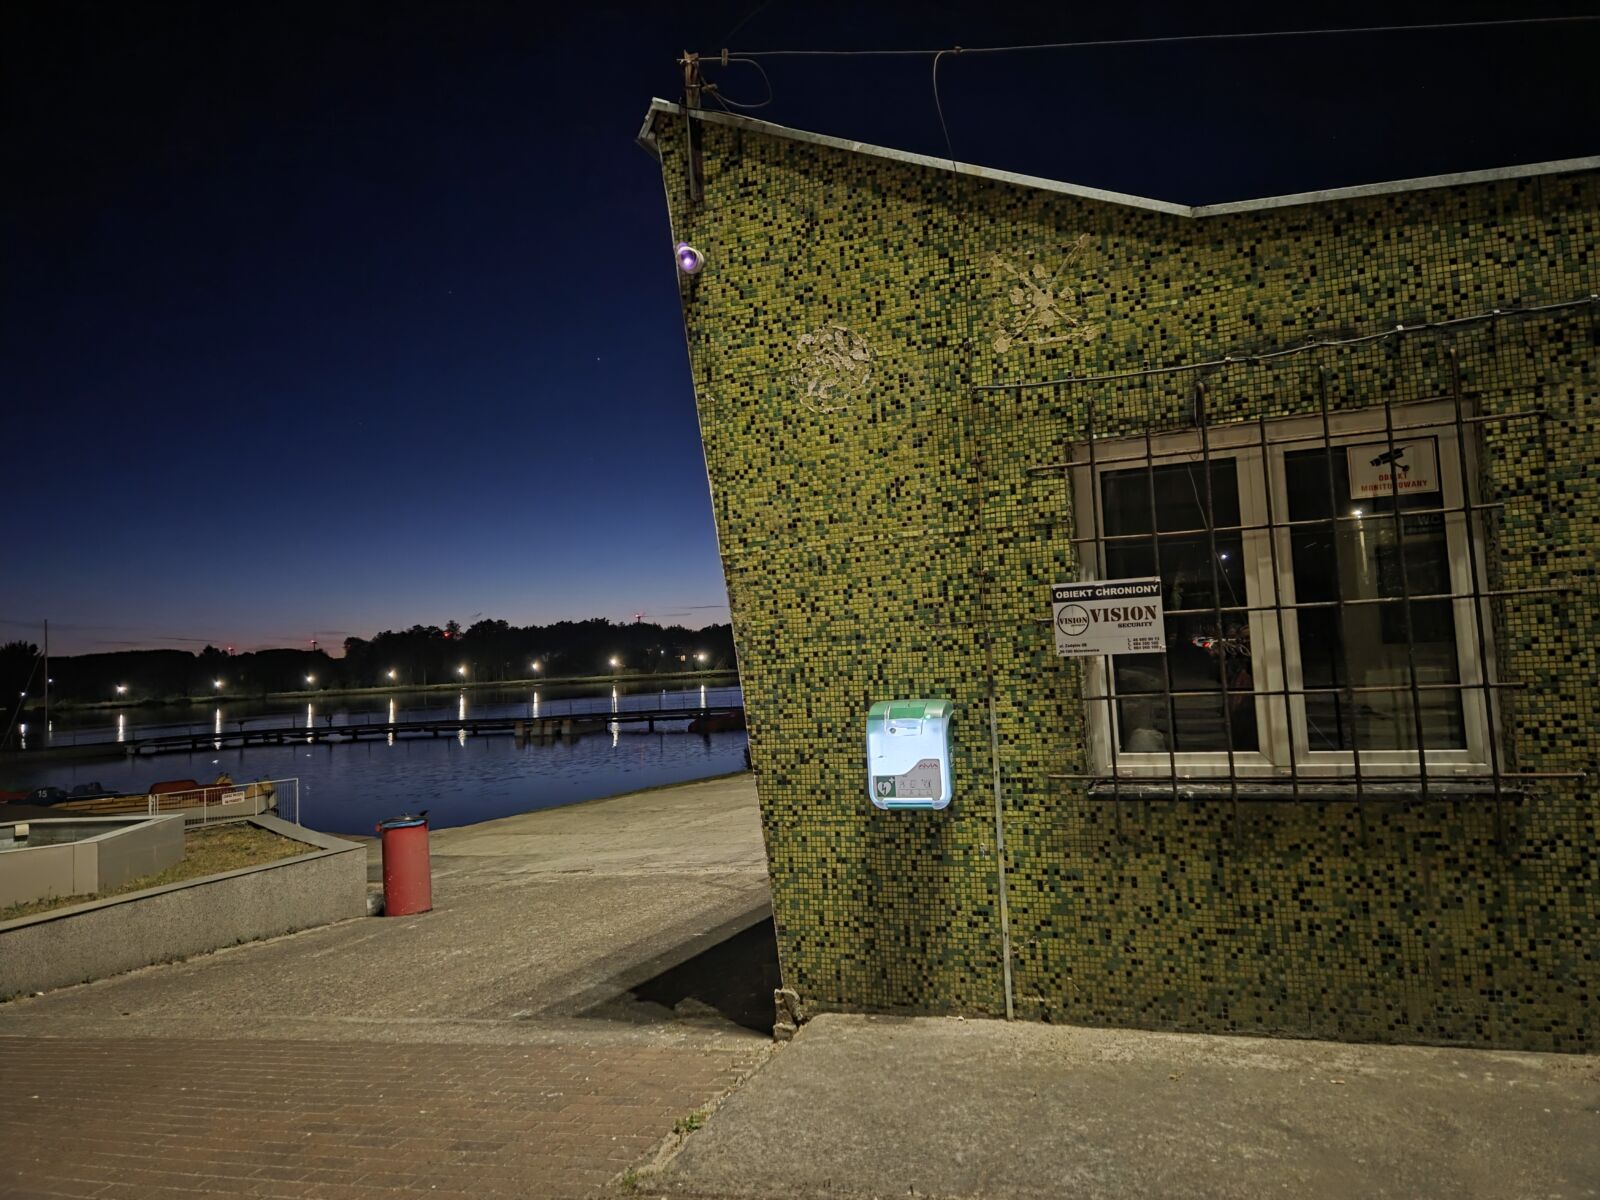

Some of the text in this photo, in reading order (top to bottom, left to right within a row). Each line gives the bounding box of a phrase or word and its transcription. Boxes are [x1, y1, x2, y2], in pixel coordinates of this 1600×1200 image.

[1378, 472, 1408, 482] OBIKT
[1360, 479, 1427, 492] MONITOOWANY
[1055, 584, 1158, 599] OBIEKT CHRONIONY
[1089, 605, 1157, 623] VISION
[1059, 616, 1088, 625] VISION
[1117, 621, 1153, 629] SECURITY
[37, 790, 47, 798] 15
